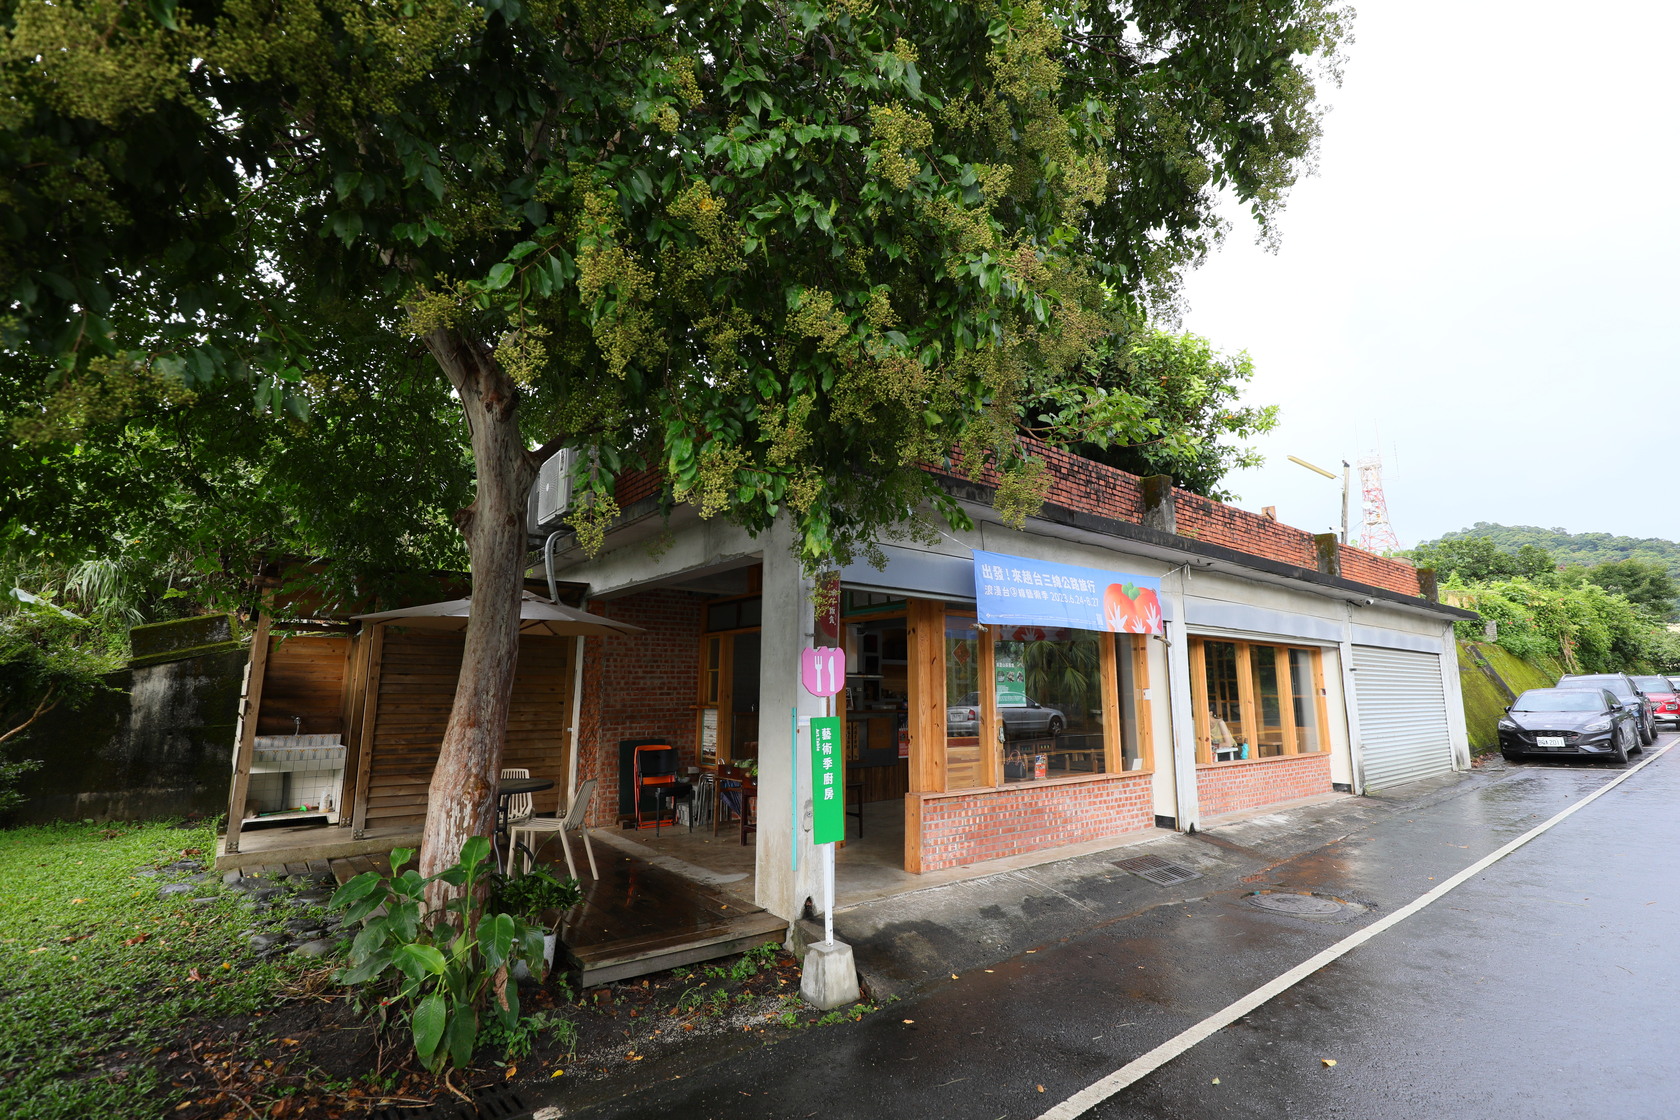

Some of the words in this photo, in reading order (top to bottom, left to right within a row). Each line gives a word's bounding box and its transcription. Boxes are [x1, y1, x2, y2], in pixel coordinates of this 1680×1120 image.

[821, 727, 834, 801] 藝術季廚房
